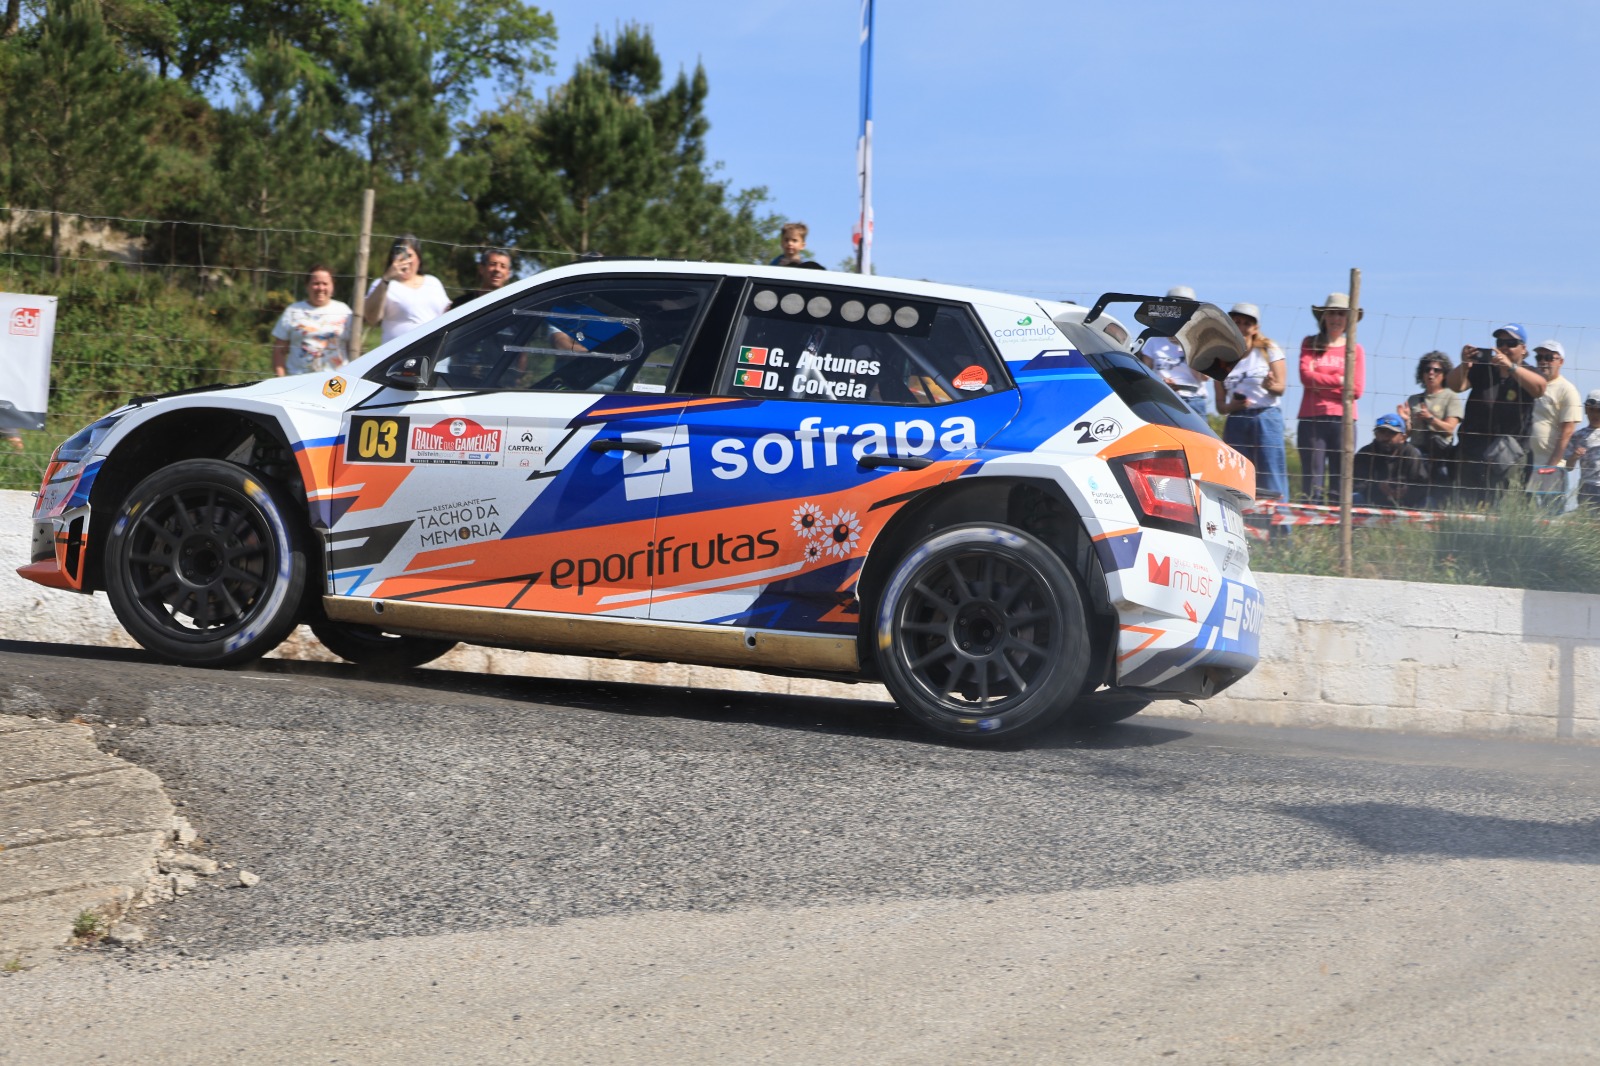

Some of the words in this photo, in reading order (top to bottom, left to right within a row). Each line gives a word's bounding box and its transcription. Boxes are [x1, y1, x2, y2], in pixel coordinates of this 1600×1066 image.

[994, 325, 1056, 338] caramulo
[769, 348, 789, 367] G.
[796, 350, 881, 376] Antunes
[764, 371, 784, 392] D.
[792, 374, 867, 398] Correia
[358, 419, 399, 459] 03
[414, 428, 443, 450] RALLYE
[455, 431, 498, 452] CAMÉLIAS
[711, 416, 977, 480] sofrapa
[417, 508, 473, 529] TACHO
[476, 504, 499, 519] DA
[433, 499, 480, 512] RESTAURANTE
[420, 522, 501, 547] MEMORIA
[550, 528, 779, 596] eporifrutas
[1173, 570, 1213, 598] must
